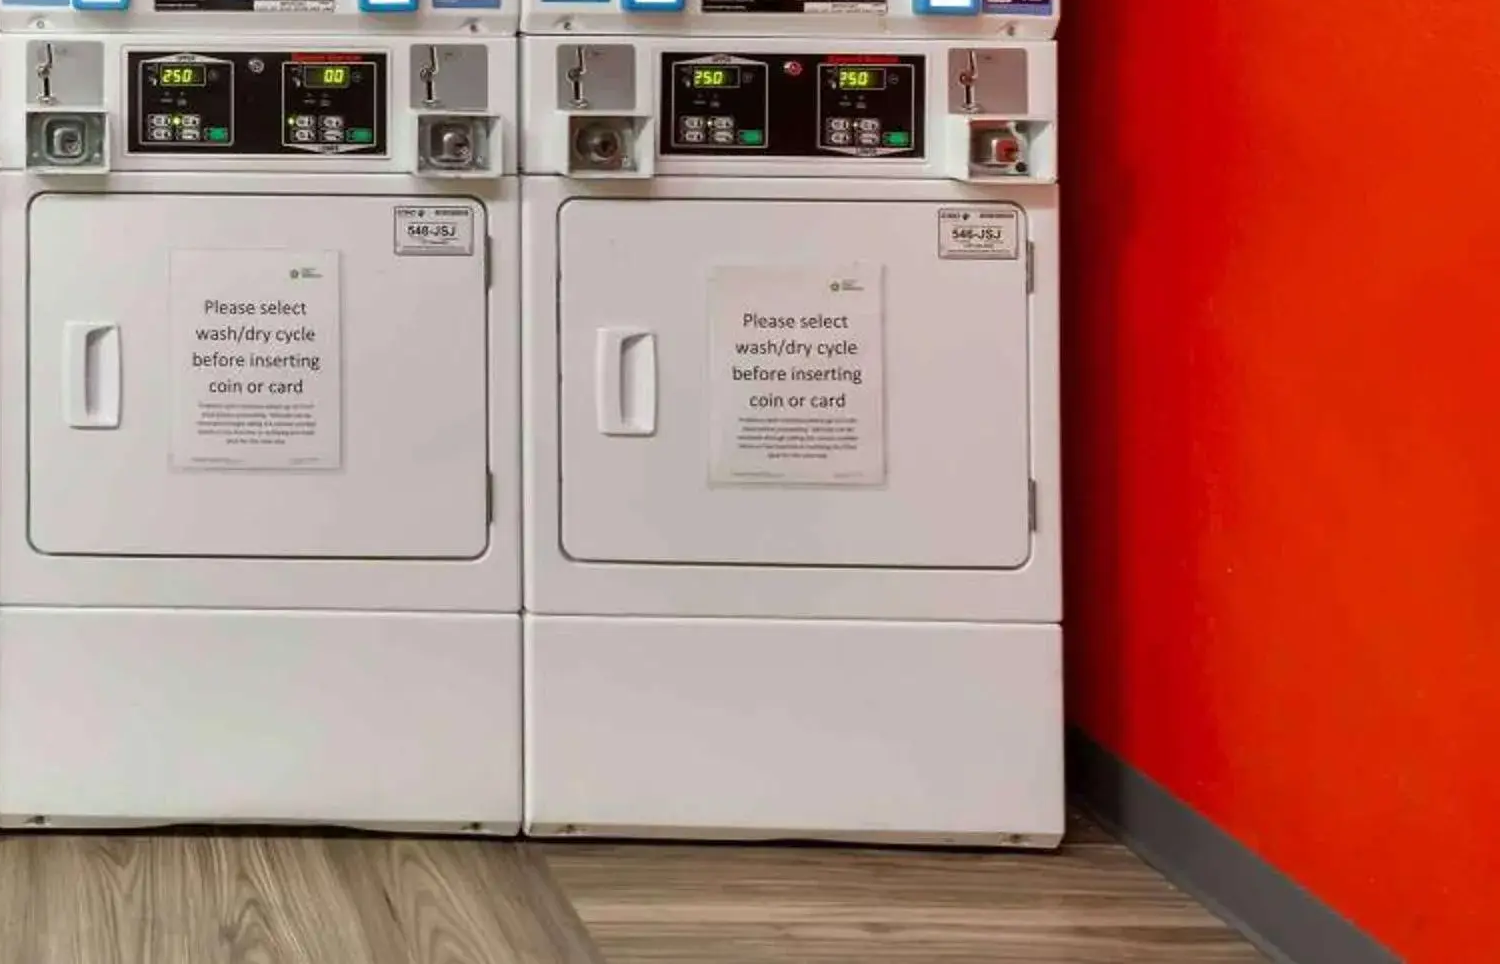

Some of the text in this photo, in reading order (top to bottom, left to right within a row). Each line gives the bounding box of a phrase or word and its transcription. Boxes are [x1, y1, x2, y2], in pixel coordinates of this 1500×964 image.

[204, 300, 307, 315] Please select
[743, 313, 848, 329] Please select
[196, 326, 316, 344] wash/dry cycle
[735, 340, 858, 358] wash/dry cycle
[192, 352, 321, 370] before inserting
[732, 366, 862, 384] before inserting
[209, 380, 303, 394] coin or card
[749, 393, 846, 408] coin or card
